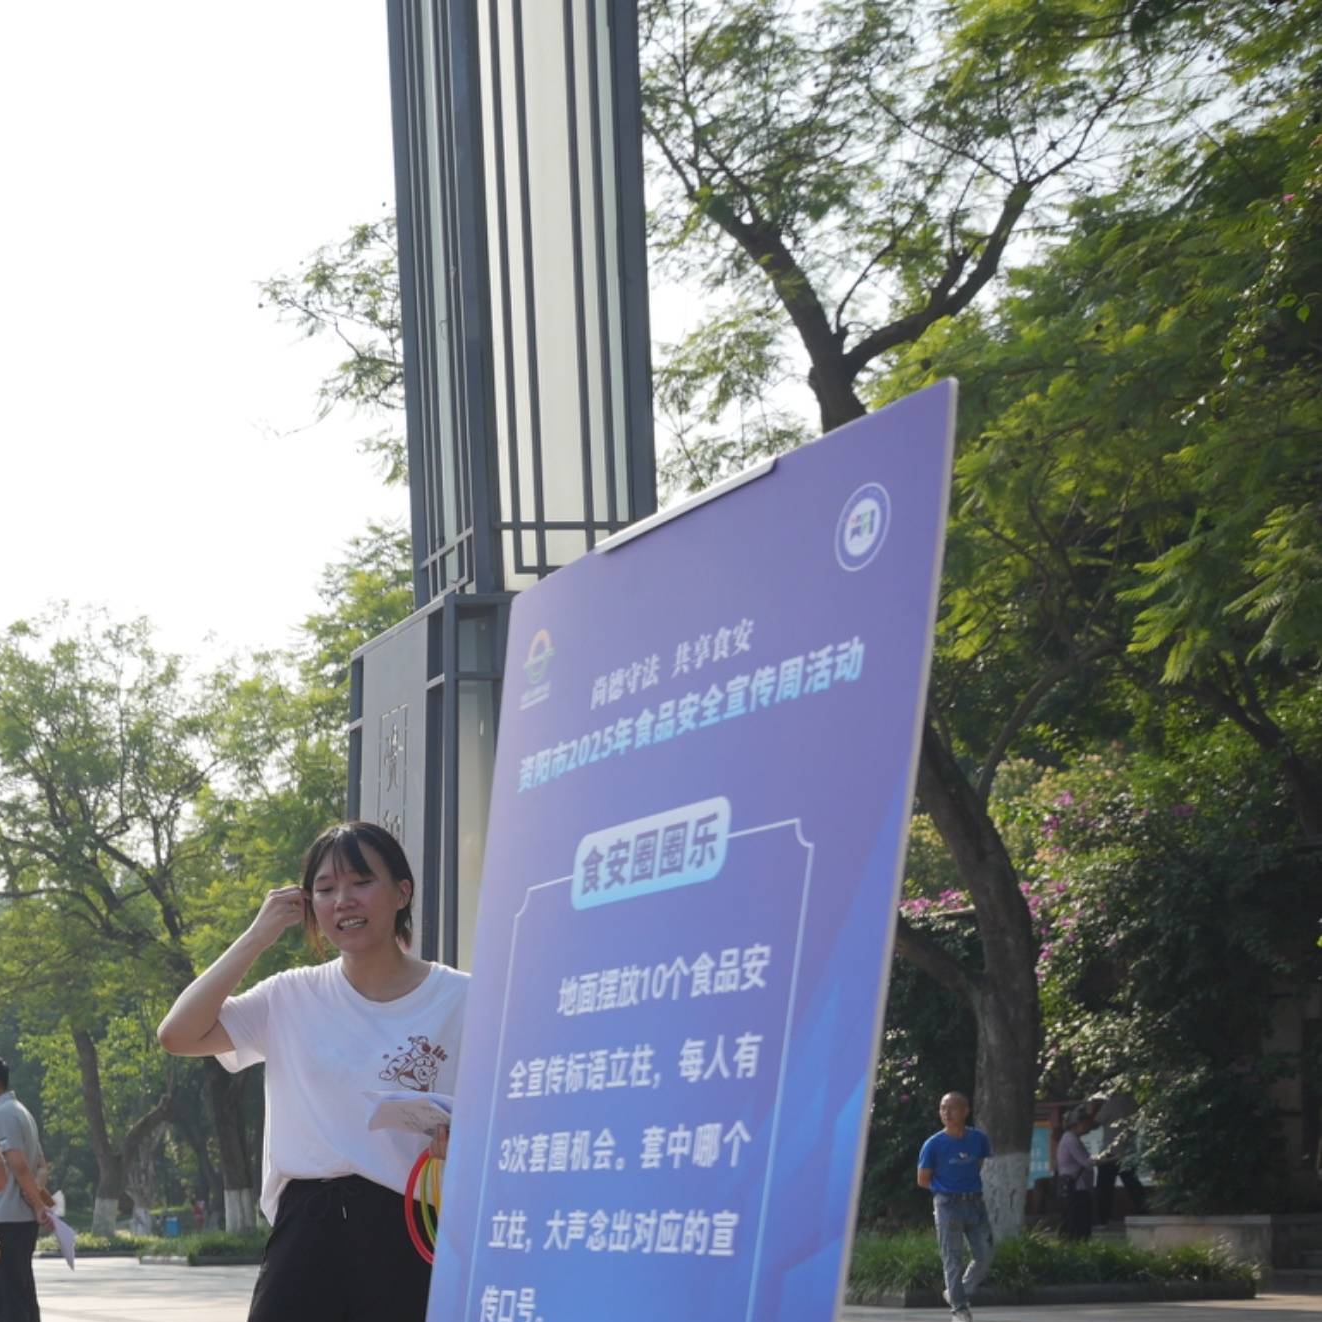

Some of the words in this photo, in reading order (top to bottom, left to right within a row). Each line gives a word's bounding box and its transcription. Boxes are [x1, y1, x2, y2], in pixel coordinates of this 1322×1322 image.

[671, 618, 754, 679] 共享食安
[517, 635, 865, 794] 资阳市2025年食品安全宣传周活动
[581, 812, 718, 896] 食安圈圈乐
[556, 943, 771, 1017] 地面摆放10个食品安
